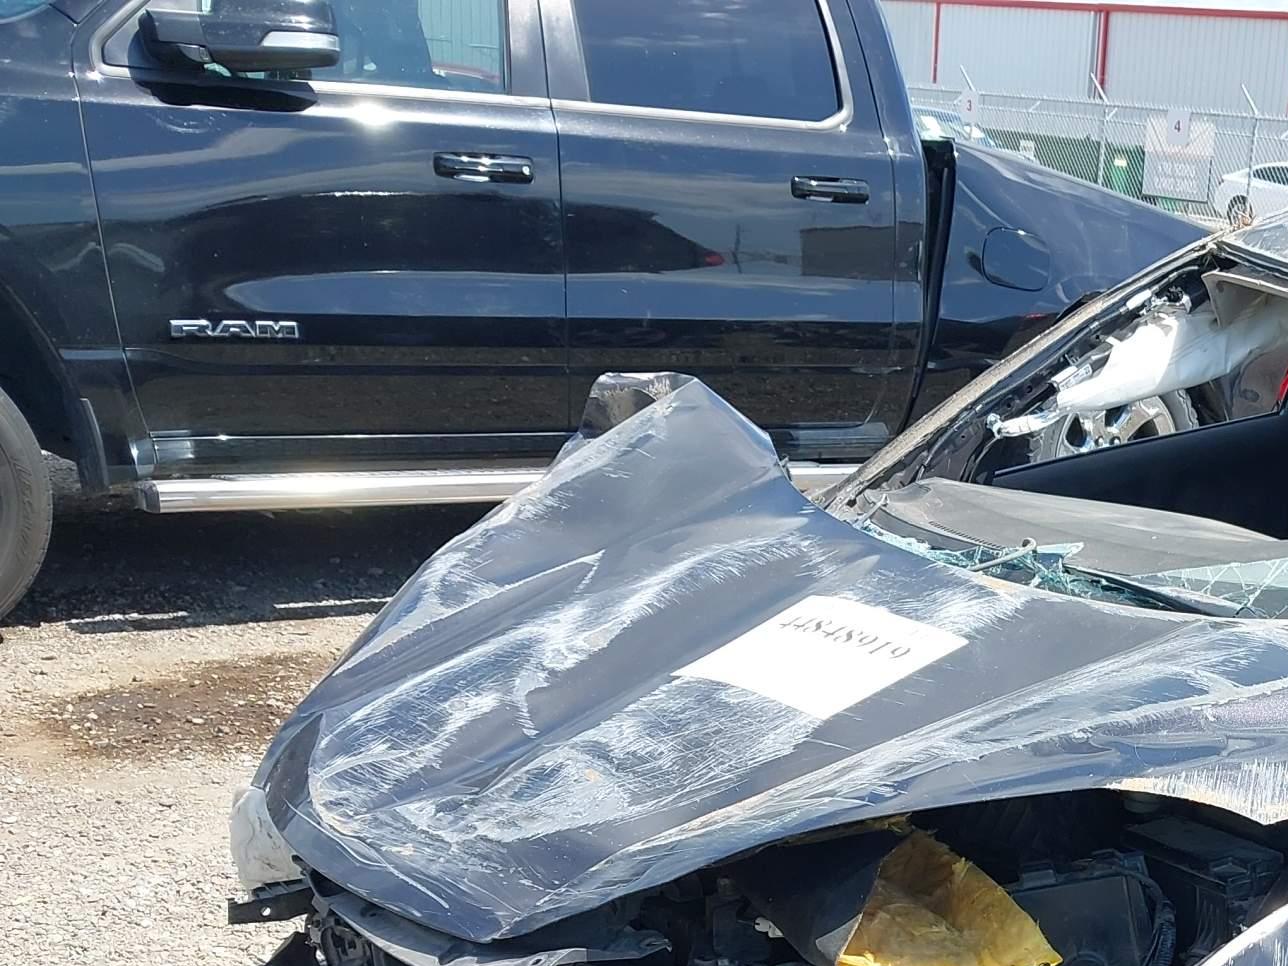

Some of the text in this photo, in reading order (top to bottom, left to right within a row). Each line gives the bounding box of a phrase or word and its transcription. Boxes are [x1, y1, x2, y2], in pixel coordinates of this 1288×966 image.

[966, 99, 972, 112] 3
[1174, 120, 1181, 133] 4
[169, 319, 299, 339] RAM
